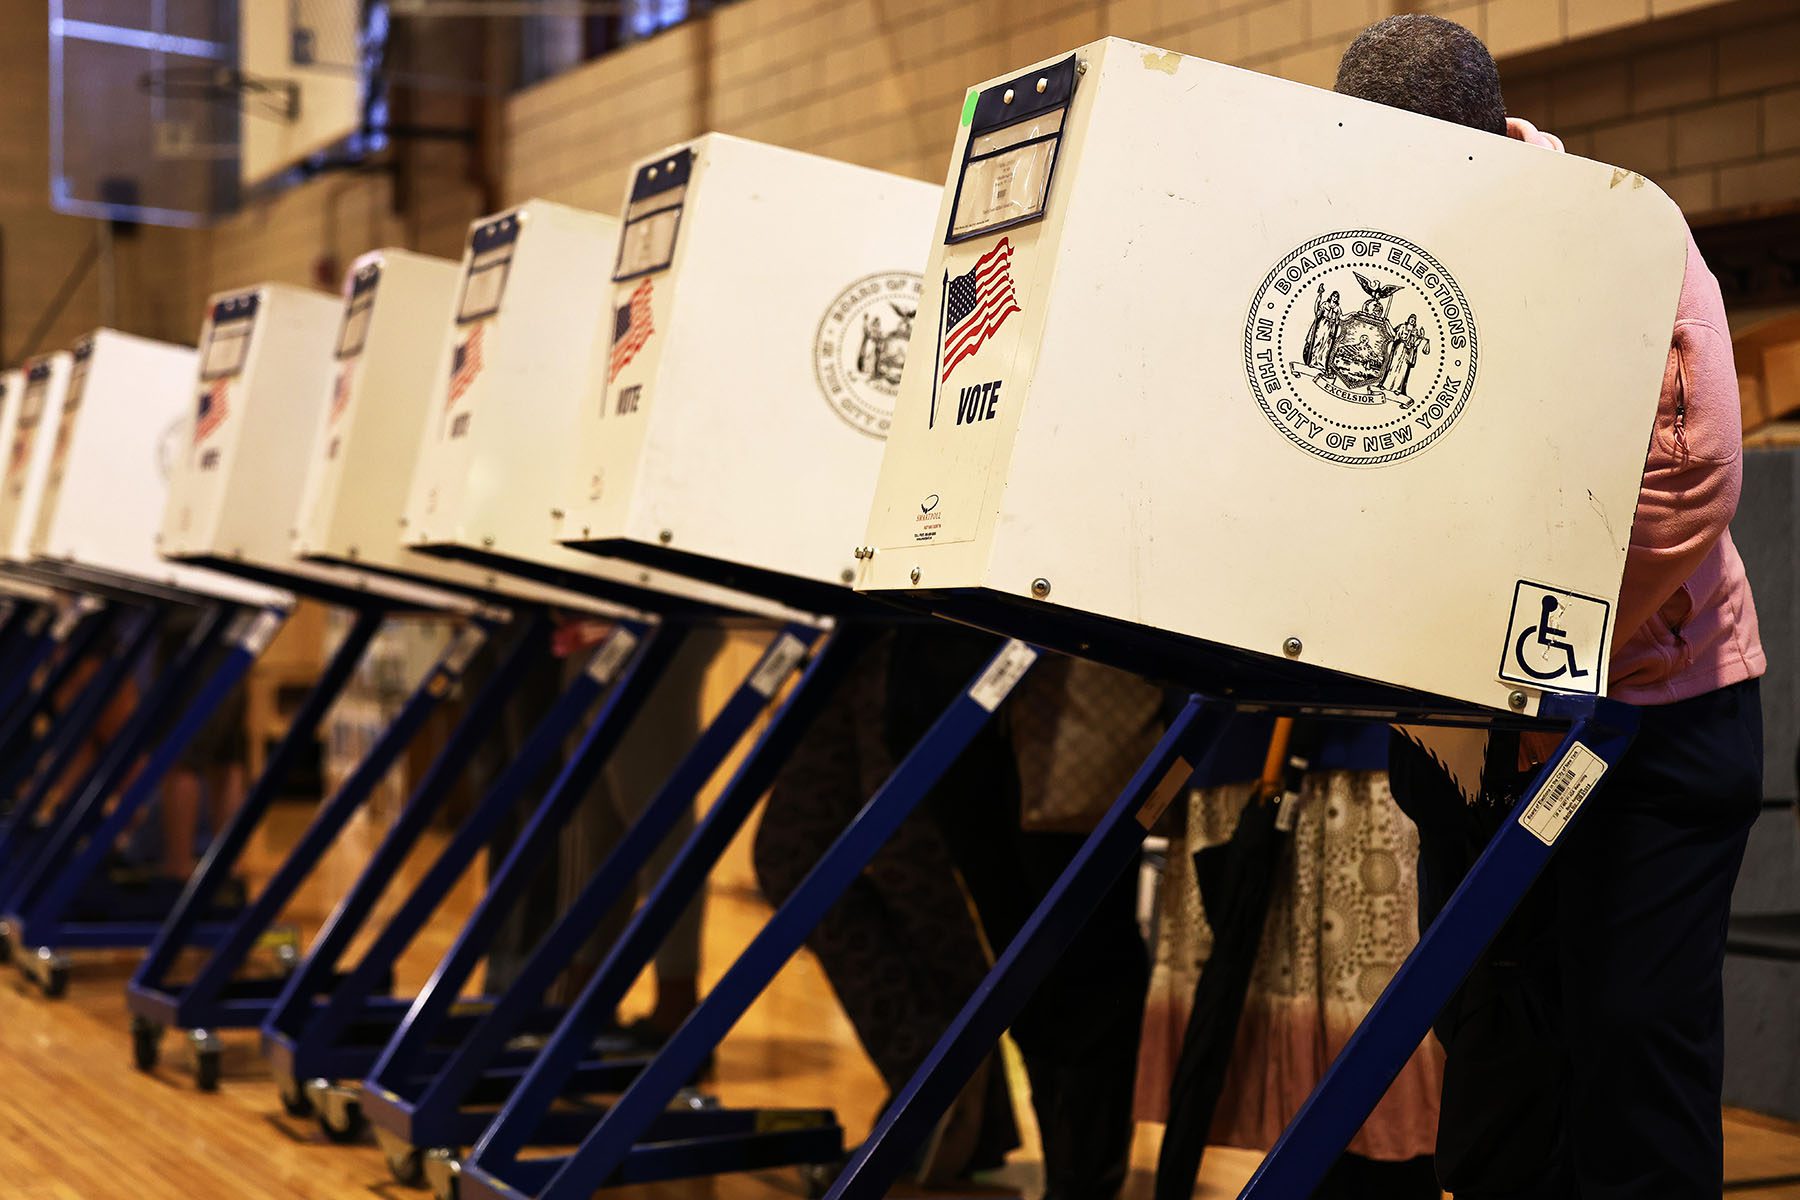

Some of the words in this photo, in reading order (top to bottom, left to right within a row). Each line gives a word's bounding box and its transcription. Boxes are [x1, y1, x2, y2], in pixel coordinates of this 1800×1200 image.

[1275, 244, 1345, 295] BOARD
[1352, 241, 1381, 256] OF
[1388, 247, 1466, 350] ELECTIONS
[1256, 318, 1274, 341] IN
[1257, 350, 1281, 393] THE
[956, 380, 1002, 426] VOTE
[1324, 384, 1374, 403] EXCELSIOR
[1416, 376, 1461, 430] YORK
[1277, 398, 1323, 439] CITY
[1363, 426, 1413, 452] NEW
[1326, 433, 1356, 451] OF
